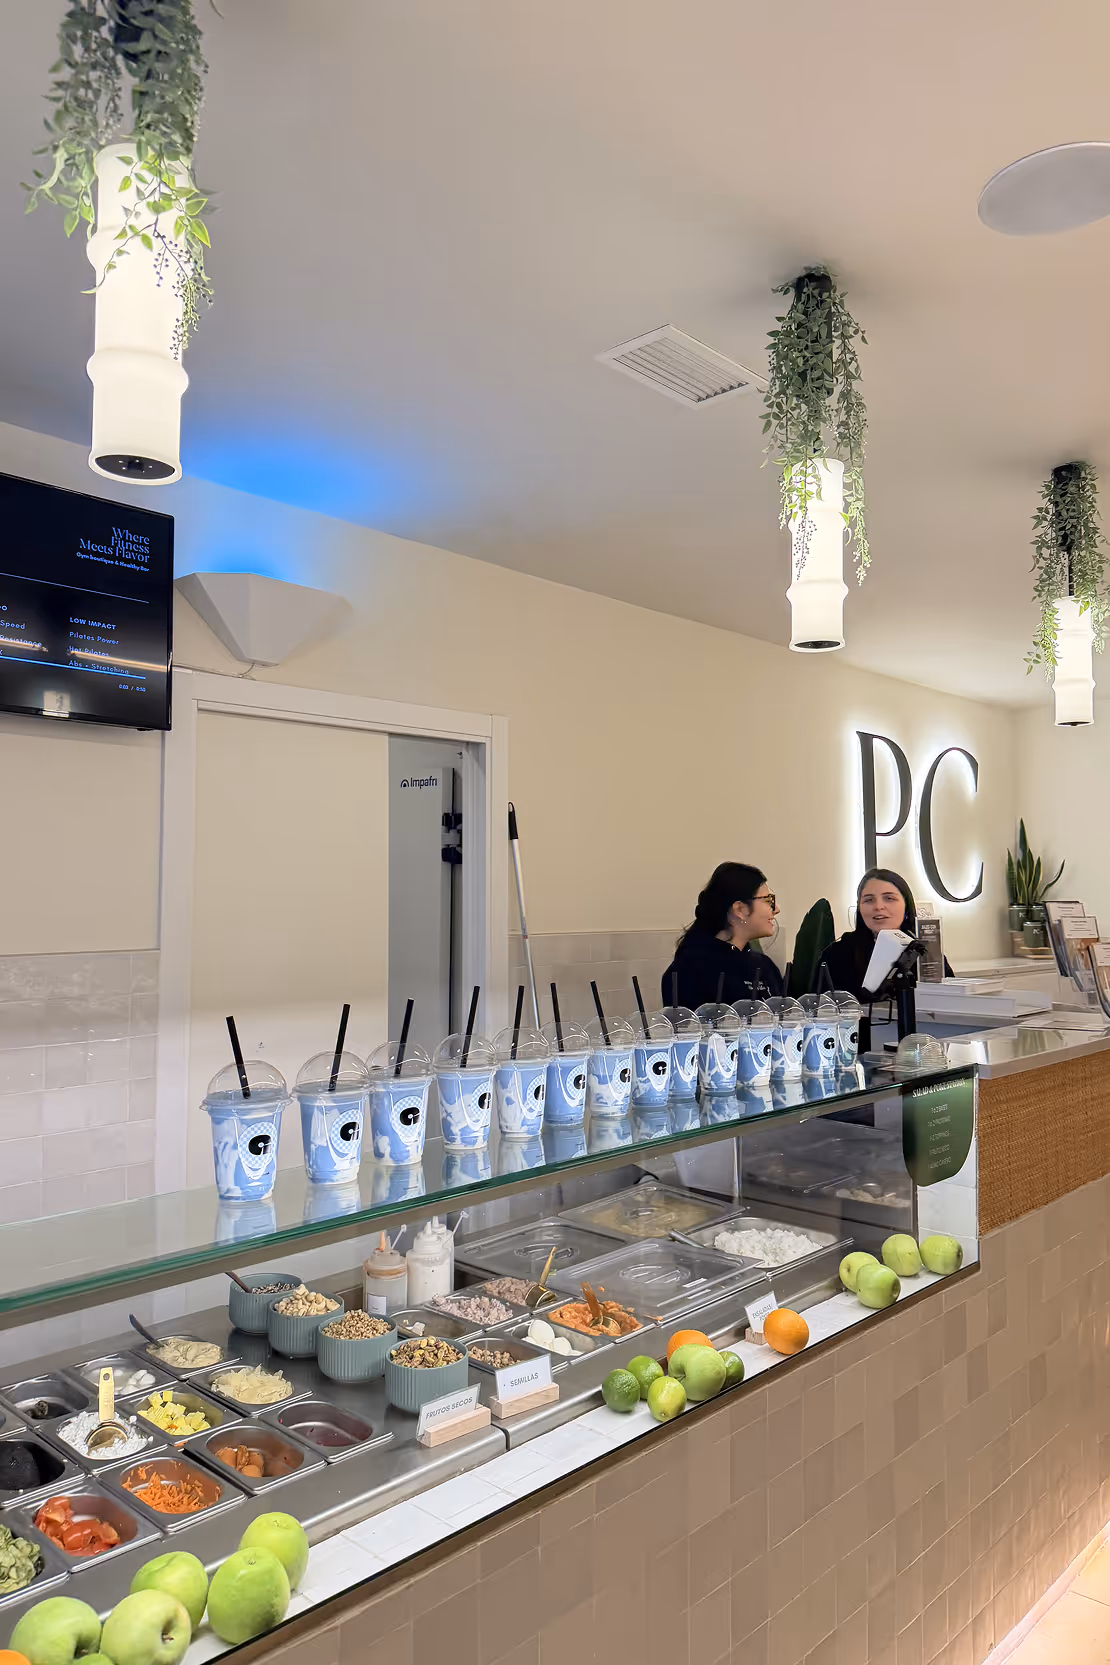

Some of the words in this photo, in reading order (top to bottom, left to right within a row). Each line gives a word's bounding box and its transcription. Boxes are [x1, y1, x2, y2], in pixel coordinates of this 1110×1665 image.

[112, 527, 150, 545] Where
[80, 538, 113, 555] Meets
[116, 546, 150, 563] Flavor
[111, 536, 150, 554] Fitness
[0, 619, 26, 630] Speed
[69, 617, 86, 625] LOW
[88, 620, 116, 630] IMPACT
[69, 631, 95, 641] Pilates
[97, 636, 119, 645] Power
[91, 663, 129, 675] Stretching
[856, 731, 983, 902] PC
[510, 1372, 539, 1388] SEMILLAS
[425, 1404, 450, 1420] FRUTOS
[451, 1396, 473, 1410] SECOS
